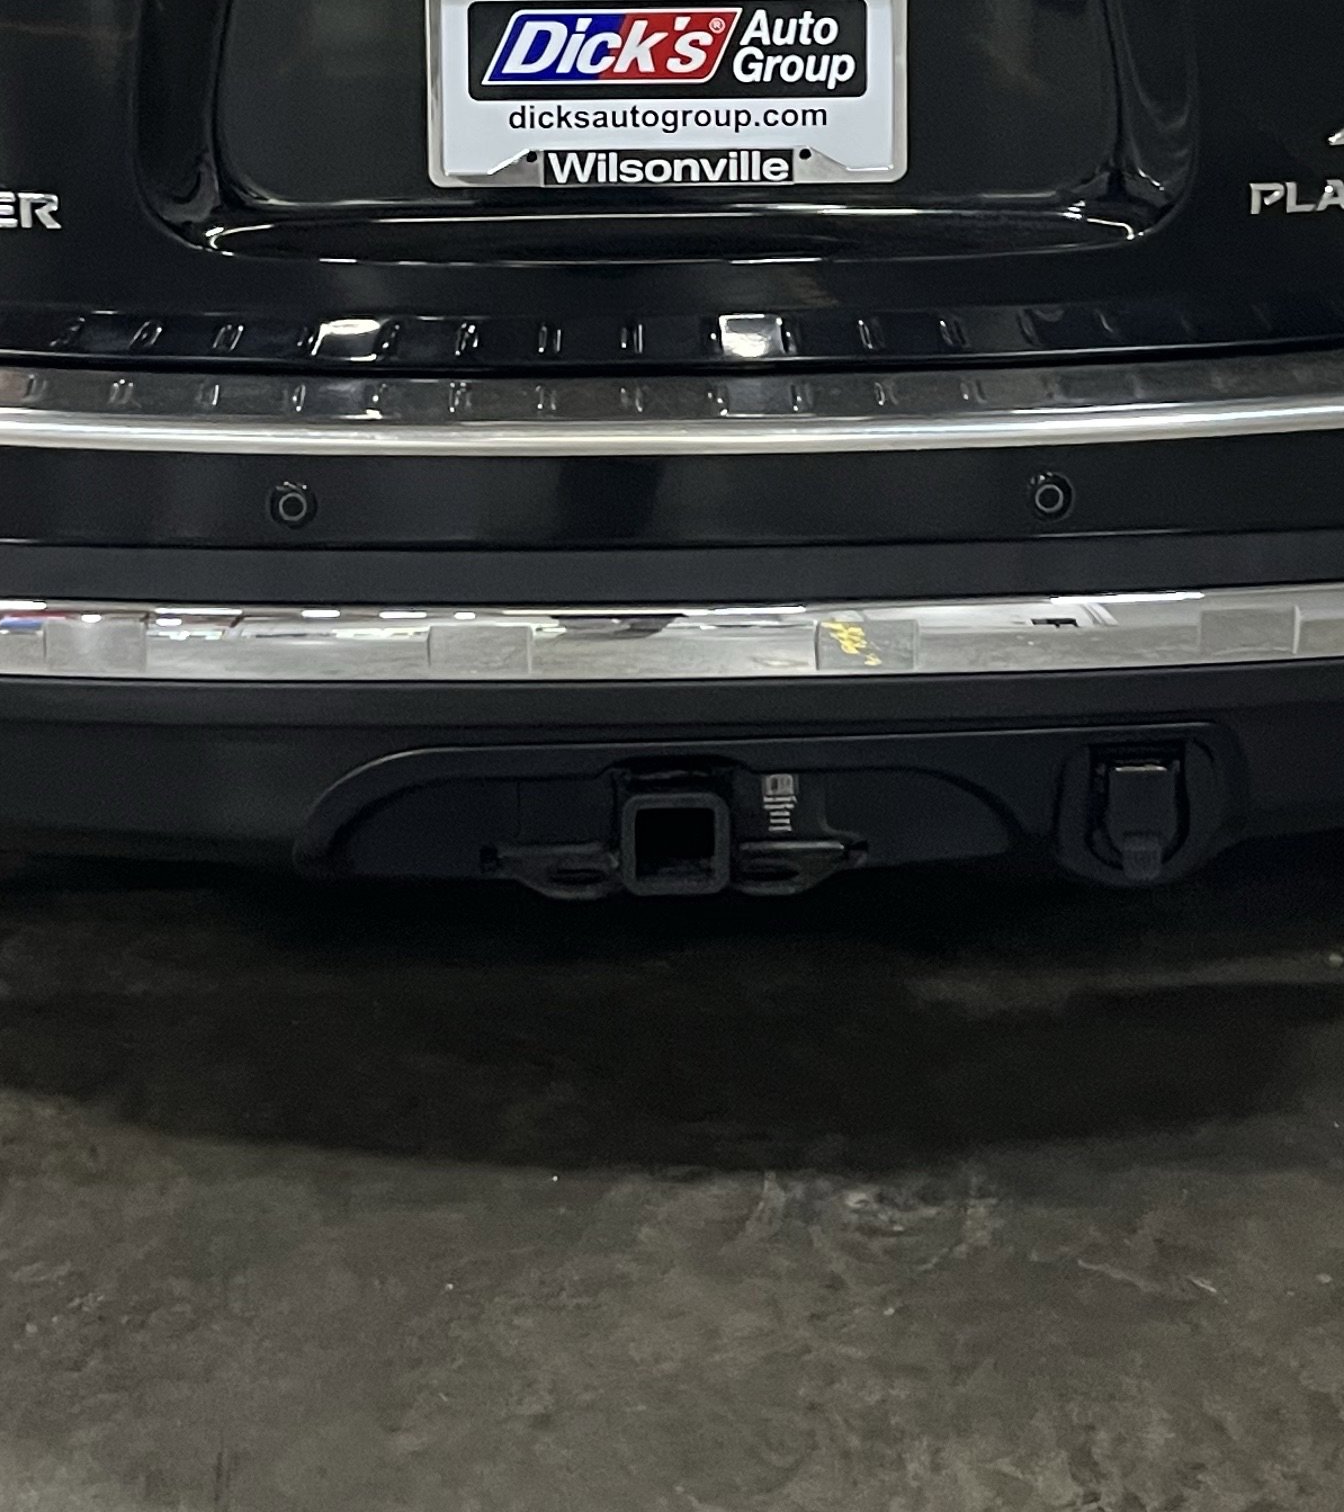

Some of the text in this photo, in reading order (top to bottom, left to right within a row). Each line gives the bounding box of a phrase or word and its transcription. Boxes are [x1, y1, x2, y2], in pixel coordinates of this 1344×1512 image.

[502, 9, 839, 74] Dick's Auto
[733, 48, 856, 90] Group
[509, 104, 829, 133] dicksautogroup.com
[546, 151, 790, 184] Wilsonville
